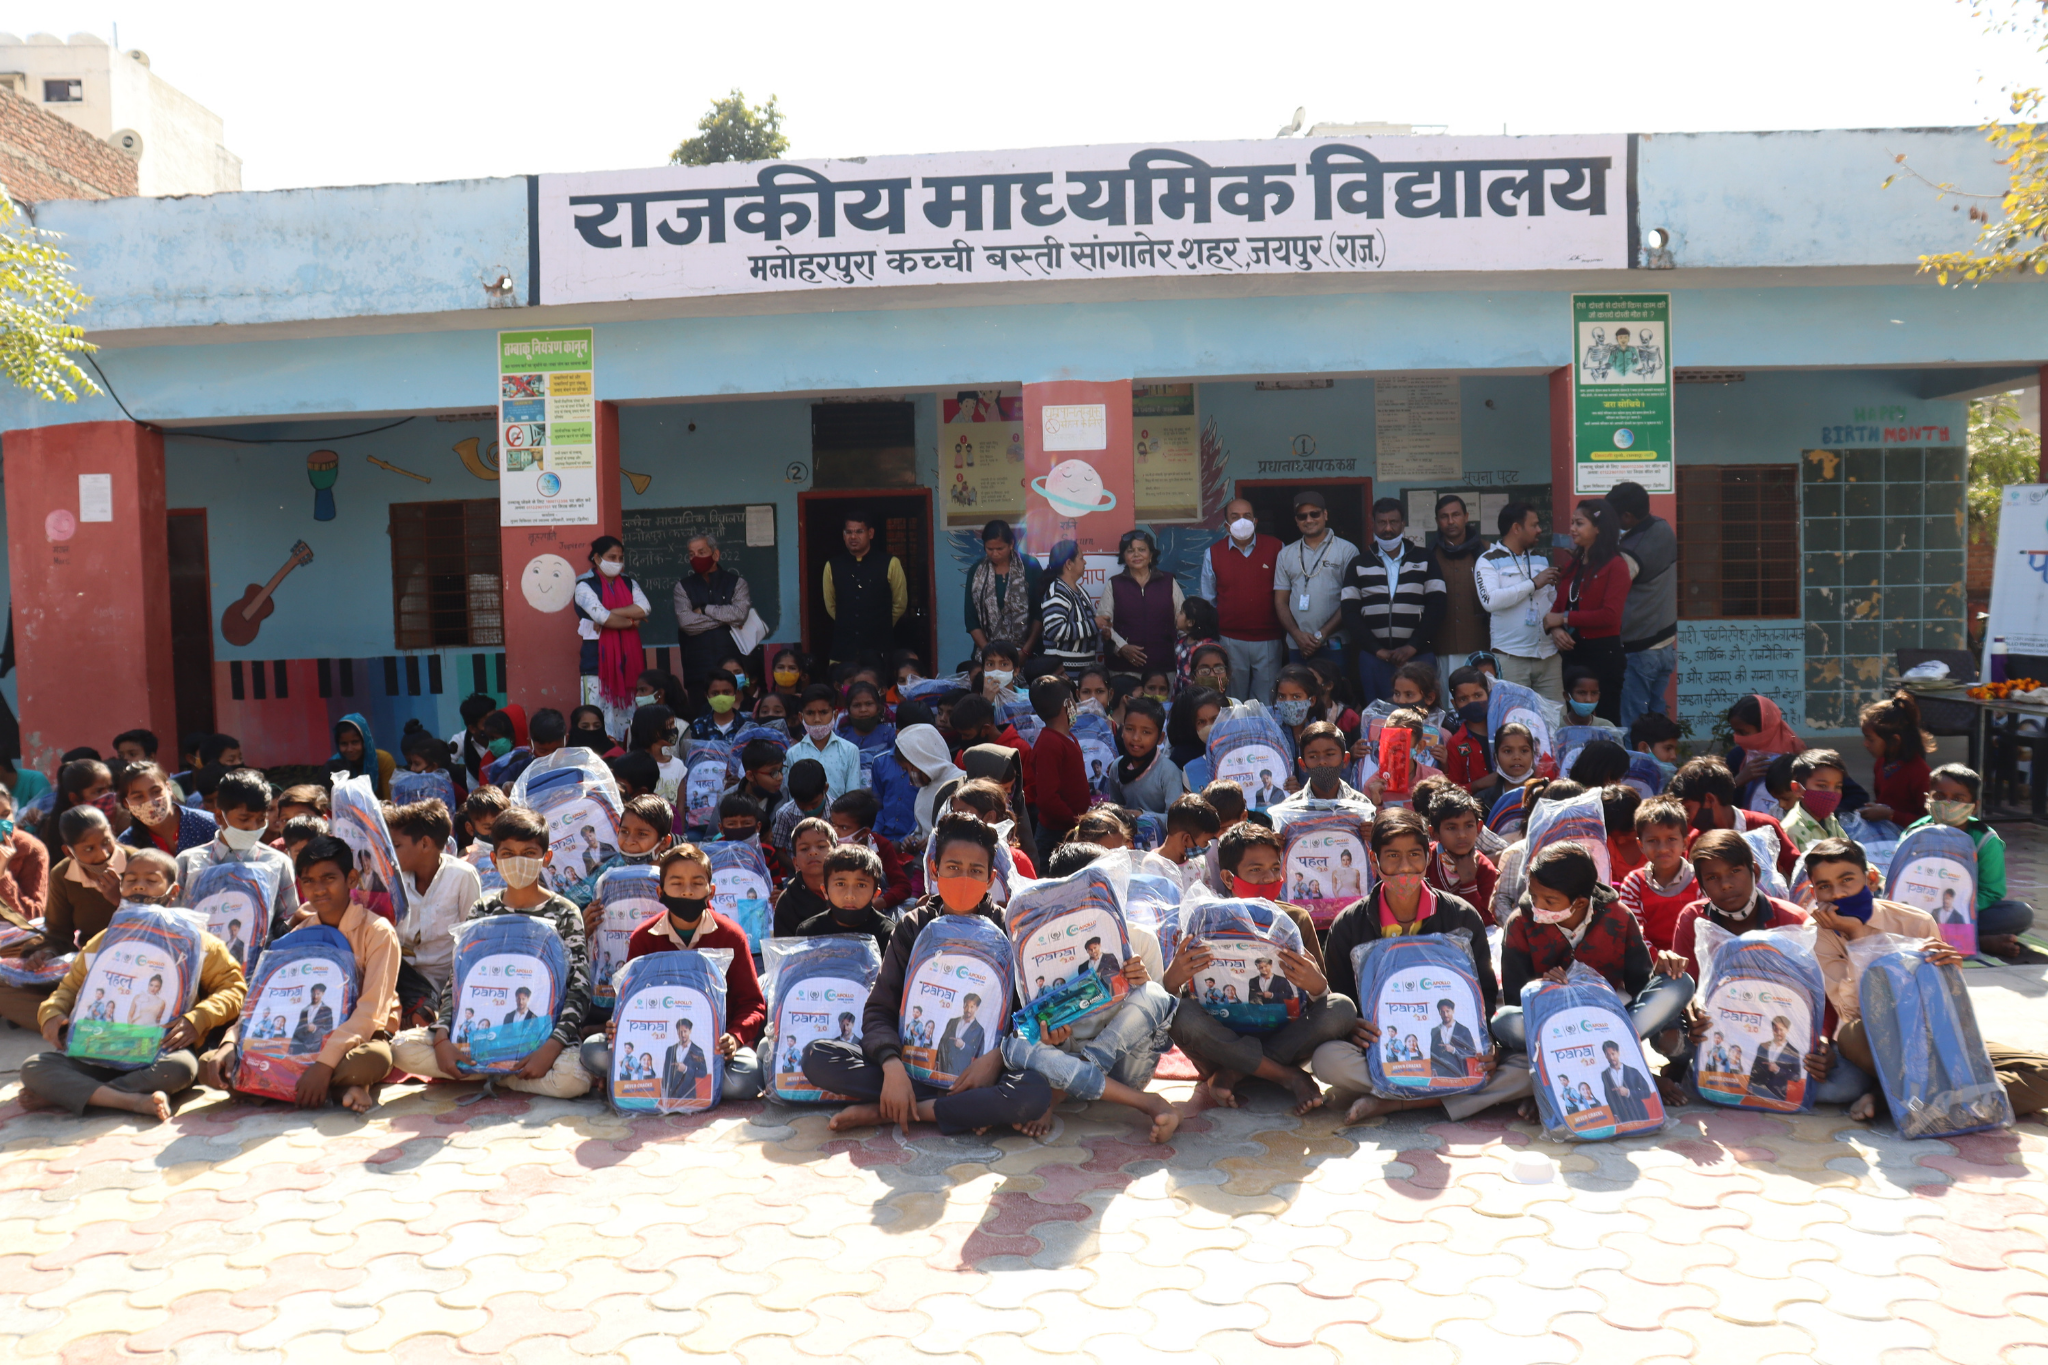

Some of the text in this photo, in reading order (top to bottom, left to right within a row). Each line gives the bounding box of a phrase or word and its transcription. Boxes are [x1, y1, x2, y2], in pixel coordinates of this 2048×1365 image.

[569, 143, 1611, 248] राजकीय माध्यमिक विद्यालय
[748, 245, 877, 284] मनोहरपुरा
[886, 239, 974, 274] कच्ची
[983, 237, 1064, 277] बस्ती
[1070, 231, 1174, 271] सांगानेर
[1247, 235, 1323, 271] जयपुर
[1611, 301, 1627, 309] दोस्ती
[1627, 301, 1641, 309] किस
[1614, 310, 1630, 318] दोस्ती
[503, 336, 588, 361] तम्बाकू नियंत्रण कानून
[1854, 405, 1907, 422] HAPPY
[1822, 425, 1950, 445] BIRTH MONTH
[1301, 438, 1308, 454] 1
[791, 466, 802, 480] 2
[1462, 471, 1494, 487] सूचना
[1060, 518, 1078, 530] शनि
[559, 541, 586, 551] Jupiter
[720, 550, 740, 561] 022
[1677, 625, 1700, 646] वादी,
[1677, 643, 1801, 665] क, आर्थिक और राजनैतिक
[1686, 666, 1703, 686] और
[1707, 670, 1733, 686] अवसर
[1734, 665, 1747, 684] की
[1751, 669, 1774, 681] समता
[1296, 856, 1331, 869] पहल
[103, 970, 138, 990] पहल
